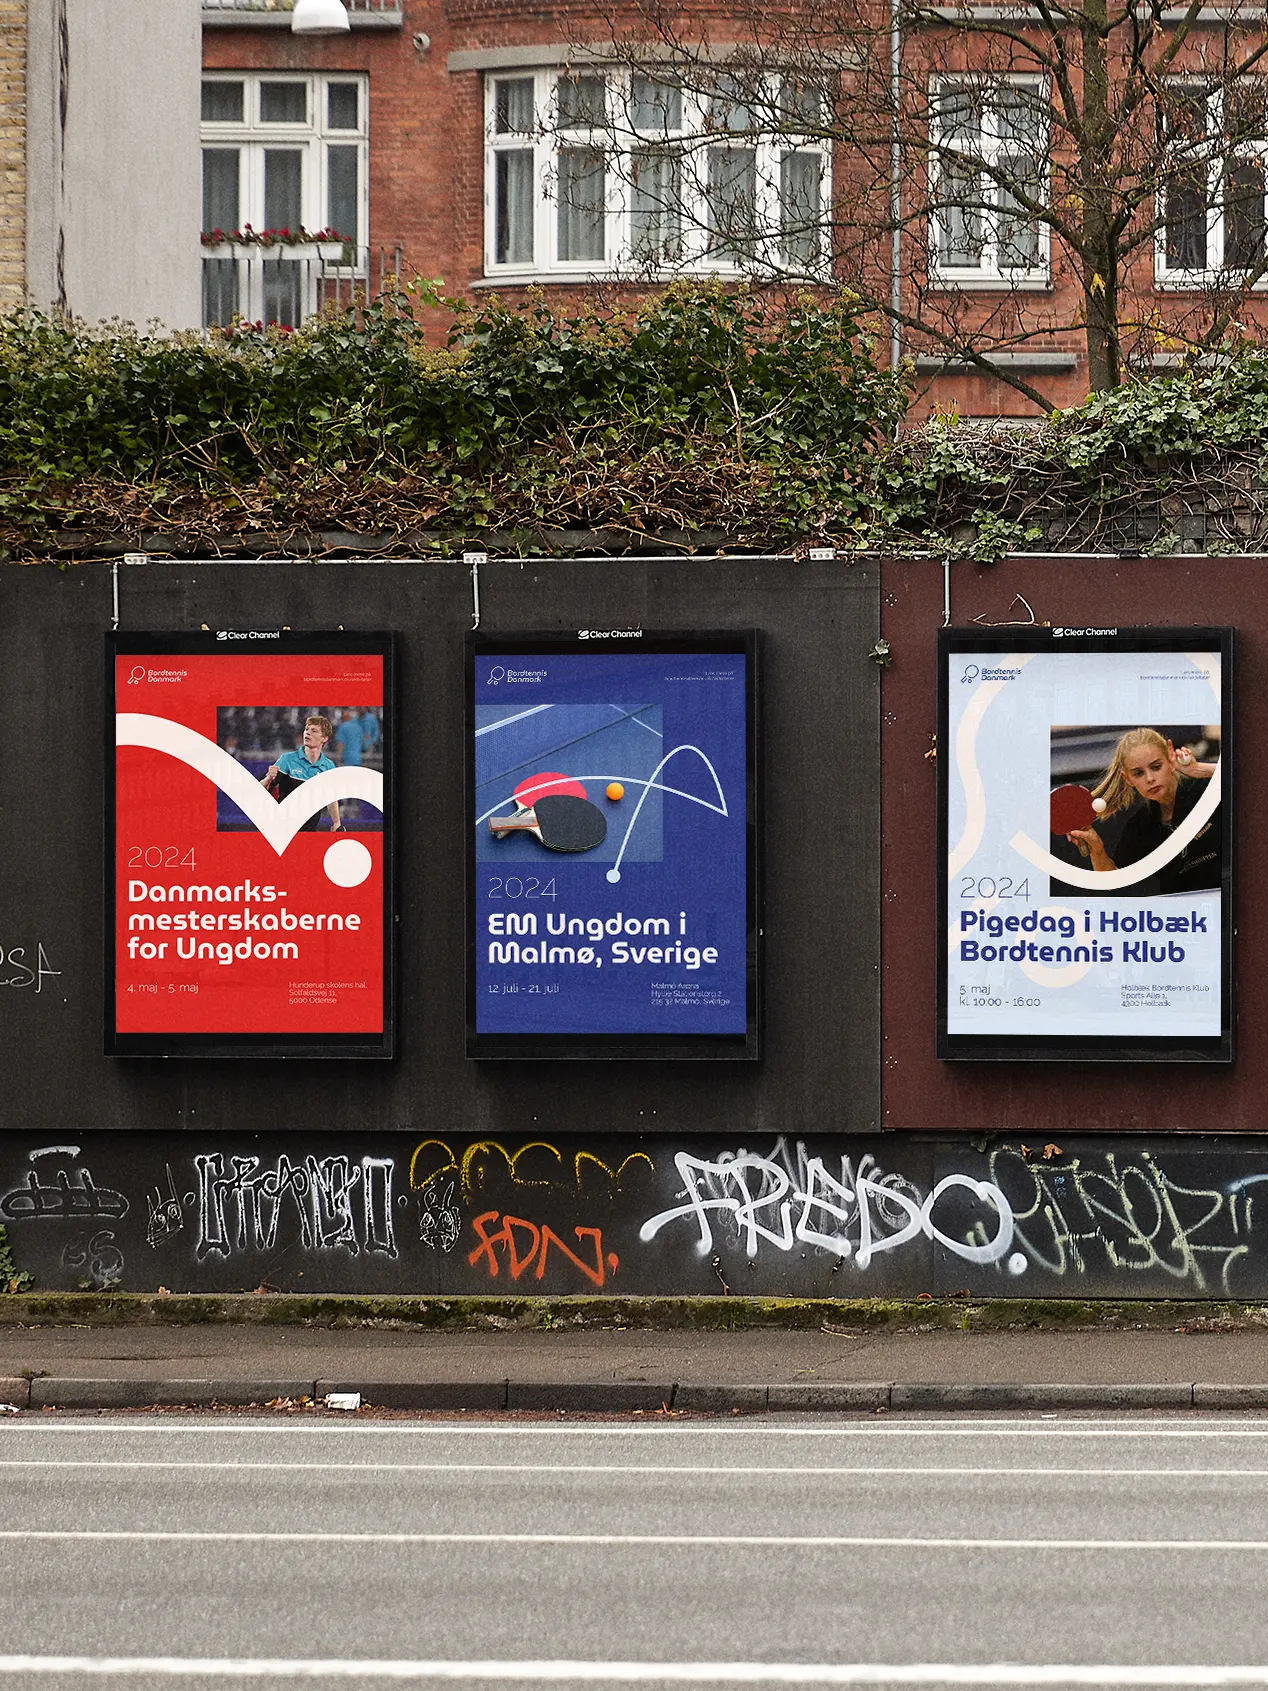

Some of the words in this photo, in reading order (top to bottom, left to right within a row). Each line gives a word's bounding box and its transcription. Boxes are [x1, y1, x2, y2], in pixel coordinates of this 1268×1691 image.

[227, 631, 249, 640] Clear
[248, 630, 280, 640] Channel
[589, 630, 611, 639] Clear
[610, 629, 643, 639] Channel
[1063, 628, 1085, 637] Clear
[1085, 627, 1118, 636] Channel
[147, 669, 188, 677] Bordtennis
[506, 669, 548, 677] Bordtennis
[981, 667, 1022, 675] Bordtennis
[147, 675, 182, 683] Danmark
[506, 675, 542, 683] Danmark
[127, 845, 197, 872] 2024
[128, 879, 288, 903] Danmarks-
[488, 876, 558, 903] 2024
[960, 876, 1032, 903] 2024
[128, 907, 361, 931] mesterskaberne
[960, 908, 1076, 939] Pigedag
[1083, 909, 1091, 933] i
[1099, 910, 1208, 933] Holbæk
[488, 912, 538, 936] EM
[546, 912, 670, 942] Ungdom
[679, 911, 687, 936] i
[126, 936, 169, 960] for
[176, 936, 299, 966] Ungdom
[488, 939, 603, 969] Malmø,
[611, 939, 719, 970] Sverige
[960, 939, 1114, 963] Bordtennis
[1122, 940, 1186, 963] Klub
[138, 982, 158, 995] maj
[179, 981, 199, 995] maj
[288, 981, 326, 990] Hunderup
[325, 981, 354, 989] skolens
[501, 982, 519, 996] juli
[542, 982, 560, 996] juli
[970, 983, 991, 996] maj
[1120, 984, 1151, 992] Holbæk
[1151, 984, 1192, 992] Bordtennis
[1192, 984, 1210, 992] Klub
[288, 997, 308, 1005] 5000
[308, 995, 338, 1004] Odense
